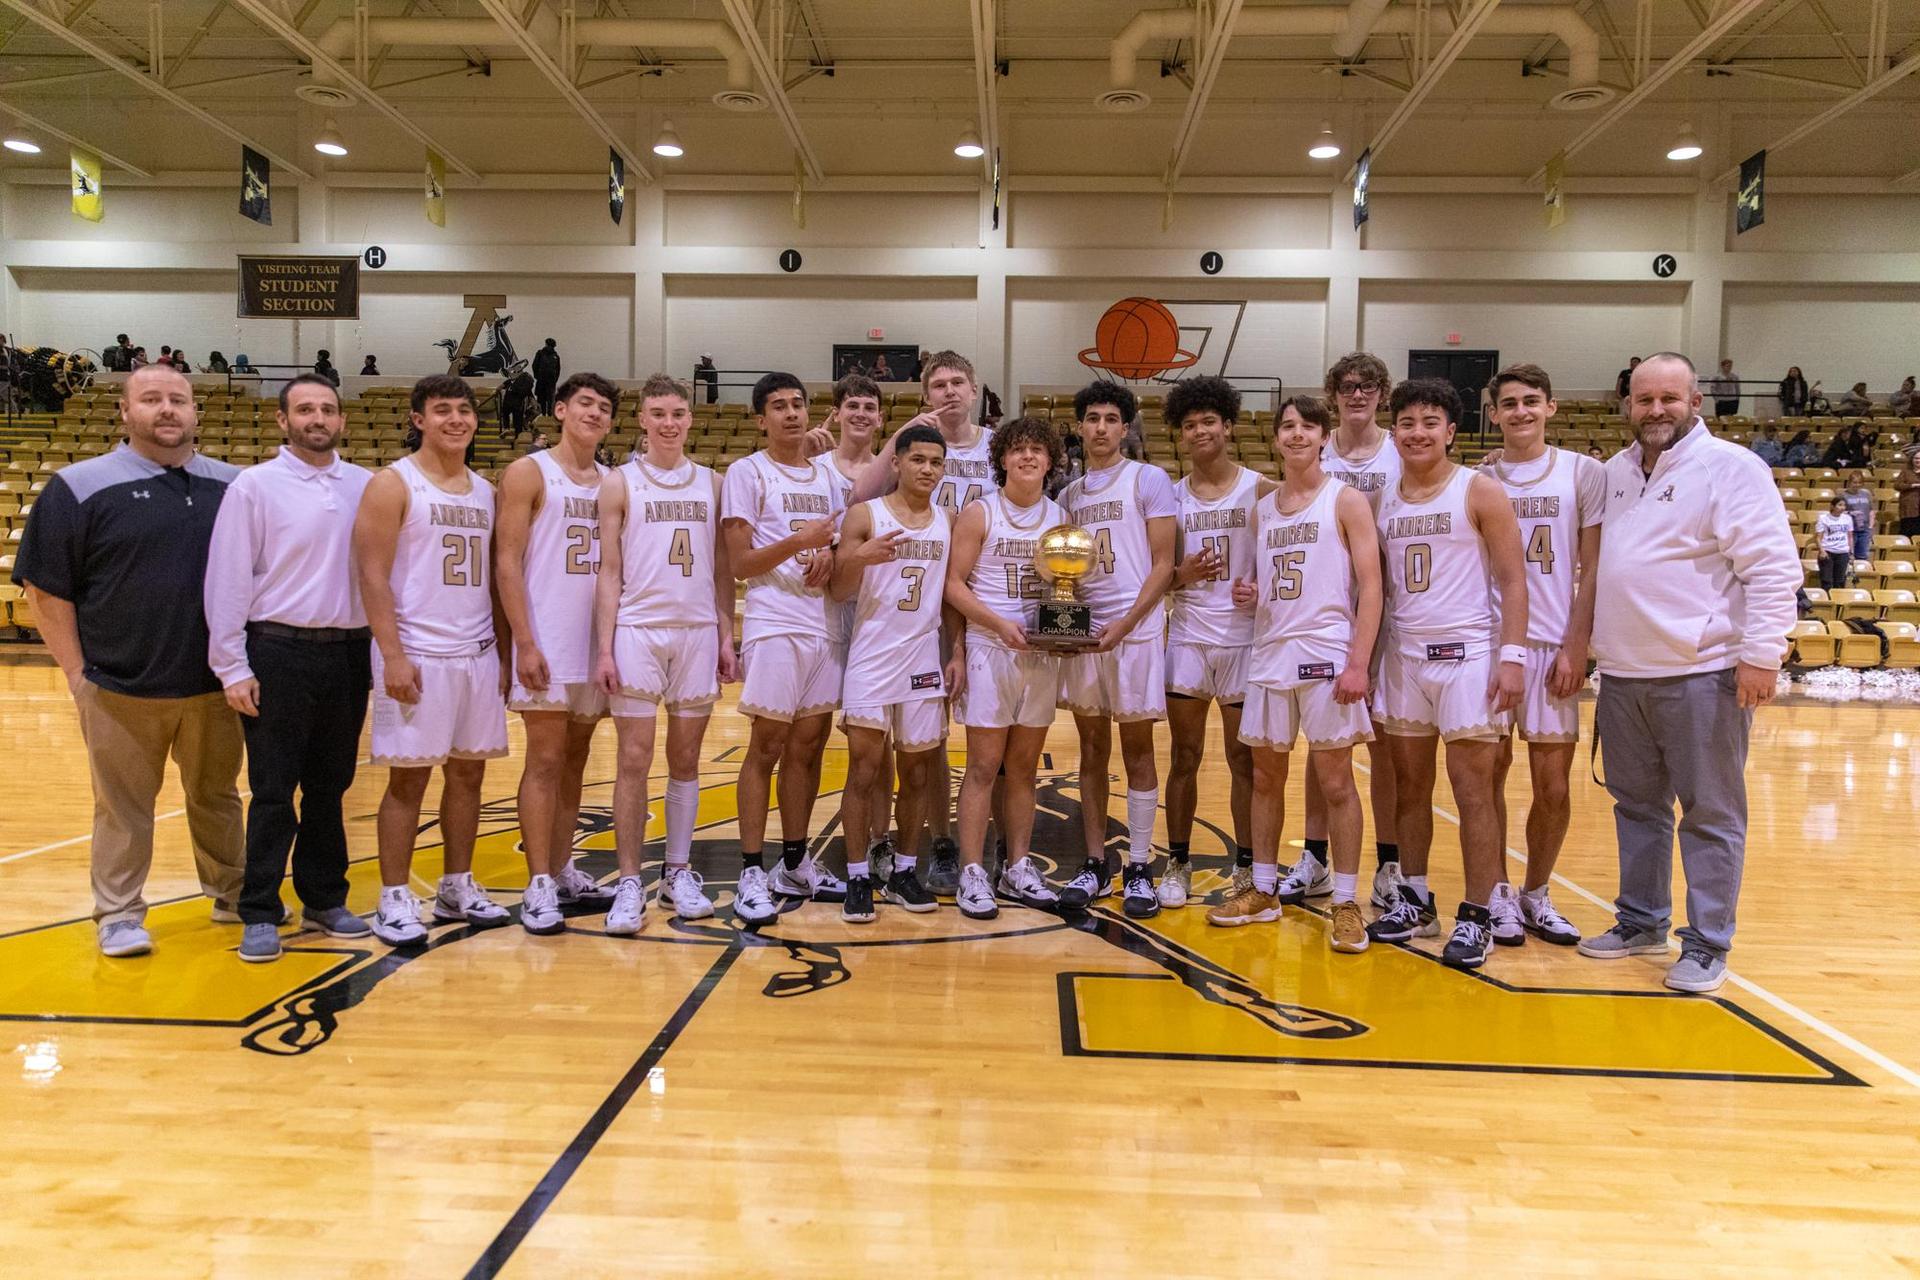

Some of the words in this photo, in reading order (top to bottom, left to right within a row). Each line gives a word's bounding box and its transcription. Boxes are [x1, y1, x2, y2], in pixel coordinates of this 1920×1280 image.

[369, 249, 382, 264] H
[1207, 255, 1216, 271] J
[1658, 257, 1672, 274] K
[257, 264, 306, 276] VISITING
[308, 264, 341, 276] TEAM
[259, 279, 339, 294] STUDENT
[262, 297, 336, 313] SECTION
[944, 458, 989, 479] DREWS
[564, 495, 600, 521] ANDR
[781, 491, 830, 515] ANDREWS
[936, 481, 983, 515] 44
[1508, 495, 1560, 519] DREWS
[430, 502, 489, 530] ANDREWS
[644, 500, 708, 524] ANDREWS
[1184, 507, 1246, 533] ANDREWS
[1266, 521, 1319, 550] ANDREWS
[1386, 511, 1452, 540] ANDREWS
[442, 533, 482, 587] 21
[668, 528, 694, 577] 4
[894, 539, 945, 561] NDREWS
[993, 537, 1037, 559] ANDR
[1270, 550, 1306, 602] 15
[1404, 542, 1432, 594] 0
[897, 565, 927, 612] 3
[1004, 562, 1042, 599] 12
[1042, 626, 1086, 636] CHAMPION
